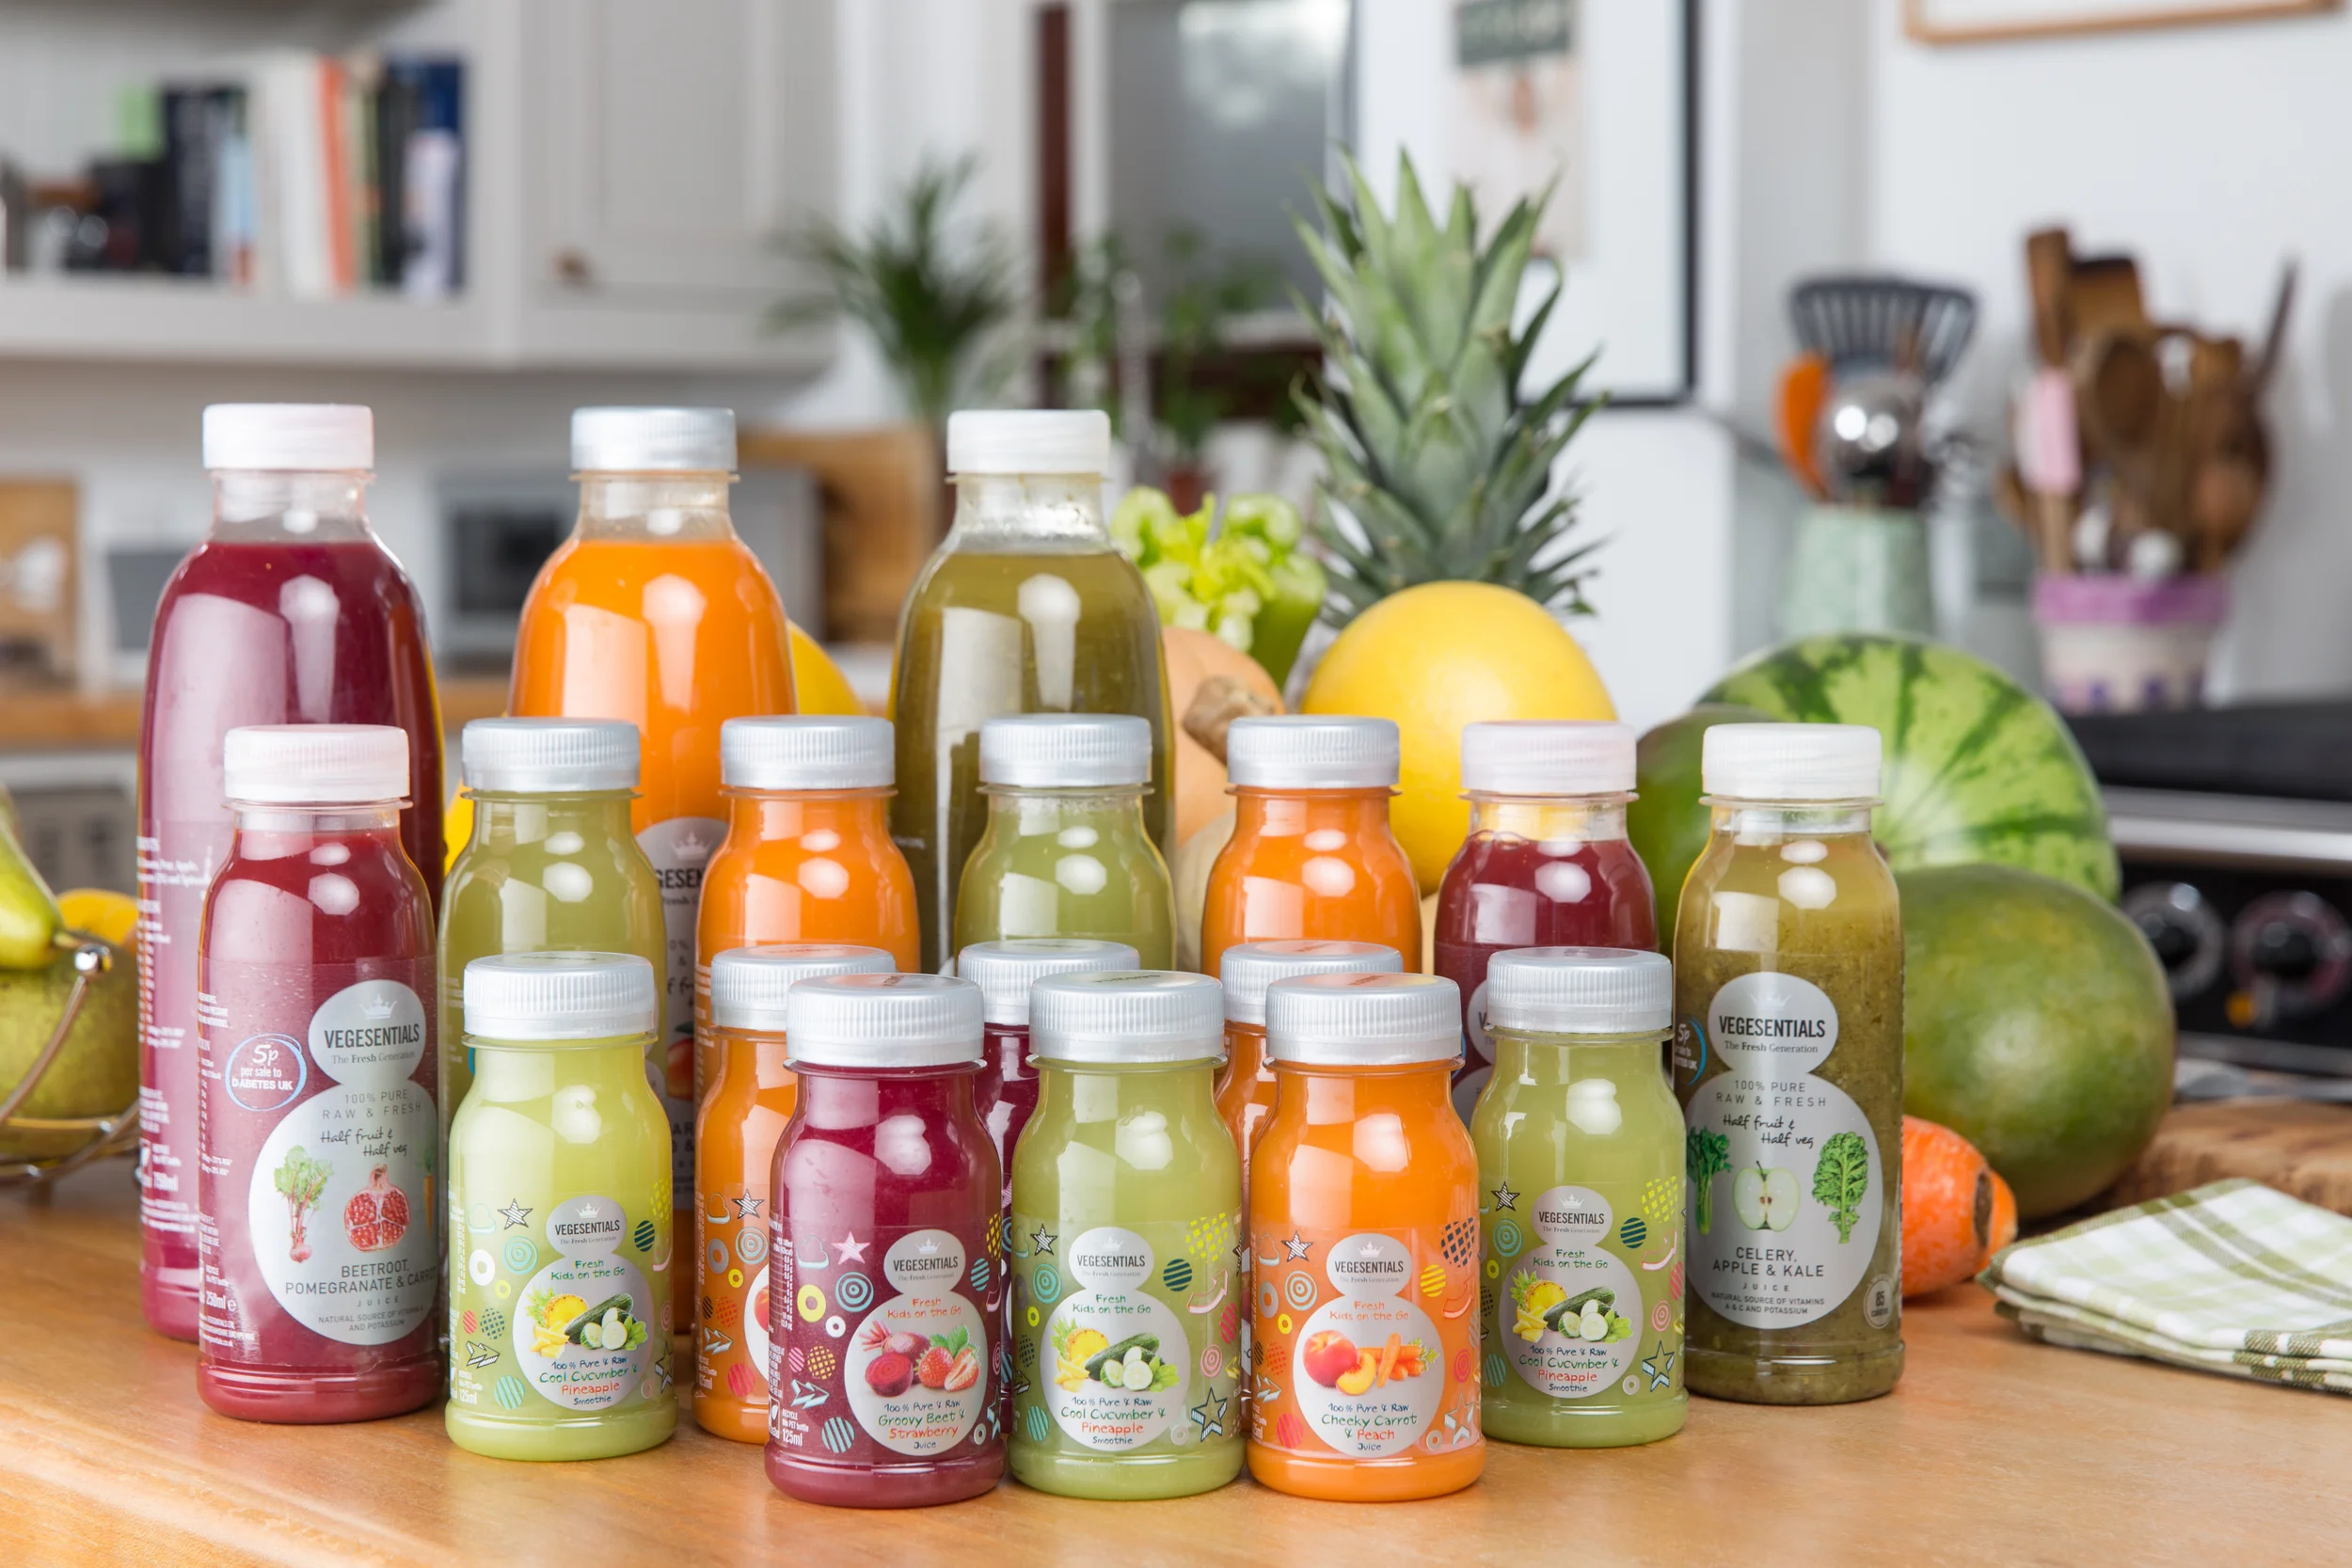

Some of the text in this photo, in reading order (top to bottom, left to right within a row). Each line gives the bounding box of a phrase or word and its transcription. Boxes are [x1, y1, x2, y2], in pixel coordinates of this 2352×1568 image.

[1719, 1015, 1826, 1037] VEGESENTIALS
[325, 1023, 420, 1049] VEGESENTIALS
[1724, 1040, 1819, 1053] The Fresh Generation
[252, 1043, 279, 1067] 5p
[332, 1051, 416, 1064] The Fresh Generation
[241, 1067, 282, 1078] per sale to
[278, 1080, 294, 1091] UK
[1735, 1080, 1806, 1093] 100% PURE
[345, 1089, 408, 1104] 100% PURE
[1716, 1092, 1826, 1107] RAW & FRESH
[323, 1102, 422, 1119] RAW & FRESH
[1723, 1113, 1751, 1130] Half
[1754, 1116, 1785, 1130] fruit
[321, 1129, 352, 1144] Half
[356, 1127, 383, 1144] fruit
[1761, 1132, 1814, 1148] Half veg
[363, 1142, 408, 1157] Half veg
[1539, 1212, 1605, 1225] VEGESENTIALS
[555, 1219, 620, 1235] VEGESENTIALS
[1556, 1249, 1585, 1259] Fresh
[1736, 1246, 1798, 1262] CELERY,
[575, 1259, 604, 1269] Fresh
[894, 1256, 958, 1272] VEGESENTIALS
[1077, 1255, 1145, 1267] VEGESENTIALS
[1335, 1260, 1404, 1273] VEGESENTIALS
[1533, 1257, 1555, 1267] Kids
[1573, 1259, 1592, 1269] the
[1595, 1259, 1609, 1269] Go
[1712, 1259, 1825, 1276] APPLE & KALE
[550, 1271, 574, 1280] Kids
[593, 1269, 611, 1278] the
[613, 1266, 626, 1276] Go
[285, 1277, 392, 1295] POMEGRANATE
[396, 1277, 405, 1288] &
[1742, 1283, 1789, 1291] JUICE
[358, 1295, 399, 1307] JUICE
[912, 1298, 941, 1307] Fresh
[1096, 1294, 1126, 1303] Fresh
[1710, 1291, 1741, 1303] NATURAL
[1744, 1295, 1774, 1305] SOURCE
[1073, 1304, 1094, 1313] Kids
[1114, 1305, 1134, 1314] the
[1137, 1305, 1152, 1314] Go
[1354, 1301, 1385, 1310] Fresh
[318, 1315, 355, 1323] NATURAL
[358, 1312, 386, 1322] SOURCE
[887, 1309, 911, 1319] Kids
[930, 1307, 947, 1317] the
[950, 1306, 961, 1315] Go
[1329, 1310, 1353, 1320] Kids
[1373, 1311, 1391, 1321] the
[1395, 1311, 1409, 1320] Go
[349, 1319, 405, 1331] AND POTASSIUM
[1556, 1347, 1577, 1355] Pure
[580, 1359, 600, 1369] Pure
[1518, 1354, 1543, 1367] Cool
[1548, 1357, 1608, 1370] Cucumber
[539, 1372, 567, 1384] Cool
[571, 1368, 629, 1382] Cucumber
[1538, 1370, 1598, 1385] Pineapple
[561, 1381, 621, 1396] Pineapple
[1549, 1383, 1588, 1392] Smoothie
[573, 1396, 612, 1405] Smoothie
[913, 1402, 933, 1411] Pure
[946, 1400, 961, 1408] Raw
[1099, 1398, 1120, 1406] Pure
[1134, 1397, 1152, 1406] Raw
[1061, 1407, 1086, 1418] Cool
[1090, 1408, 1153, 1420] Cucumber
[1356, 1403, 1377, 1413] Pure
[1391, 1403, 1409, 1412] Raw
[879, 1415, 922, 1428] Groovy
[927, 1411, 956, 1424] Beet
[1322, 1412, 1418, 1429] Cheeky Carrot
[888, 1426, 959, 1440] Strawberry
[1081, 1421, 1145, 1436] Pineapple
[1357, 1430, 1395, 1440] Peach
[782, 1428, 803, 1447] 125ml
[1092, 1435, 1133, 1445] Smoothie
[914, 1441, 936, 1449] Juice
